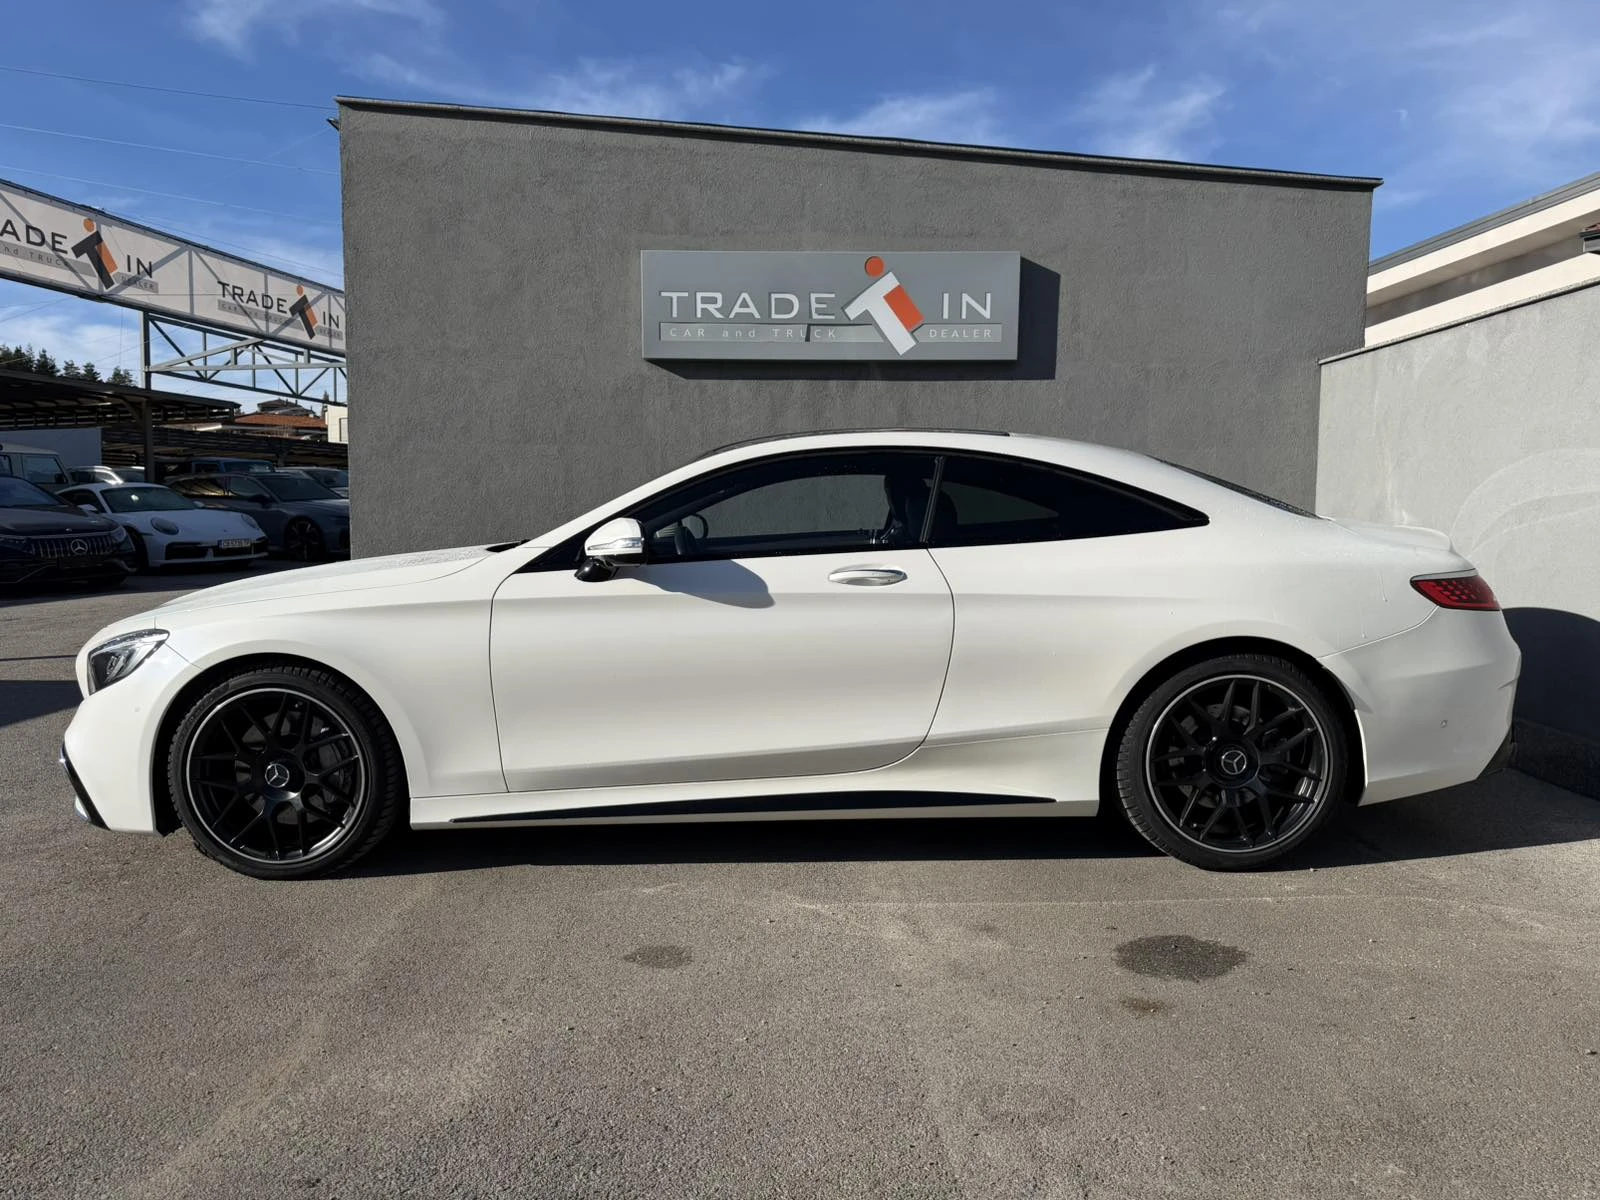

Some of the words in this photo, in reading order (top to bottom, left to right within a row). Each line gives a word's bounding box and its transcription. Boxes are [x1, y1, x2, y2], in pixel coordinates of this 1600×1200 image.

[29, 251, 67, 268] TRUC
[127, 255, 153, 278] IN
[217, 280, 287, 314] TRADE
[323, 311, 340, 329] IN
[660, 291, 836, 320] TRADE
[942, 292, 992, 320] IN
[669, 328, 705, 338] CAR
[722, 328, 756, 338] and
[928, 329, 993, 339] DEALER
